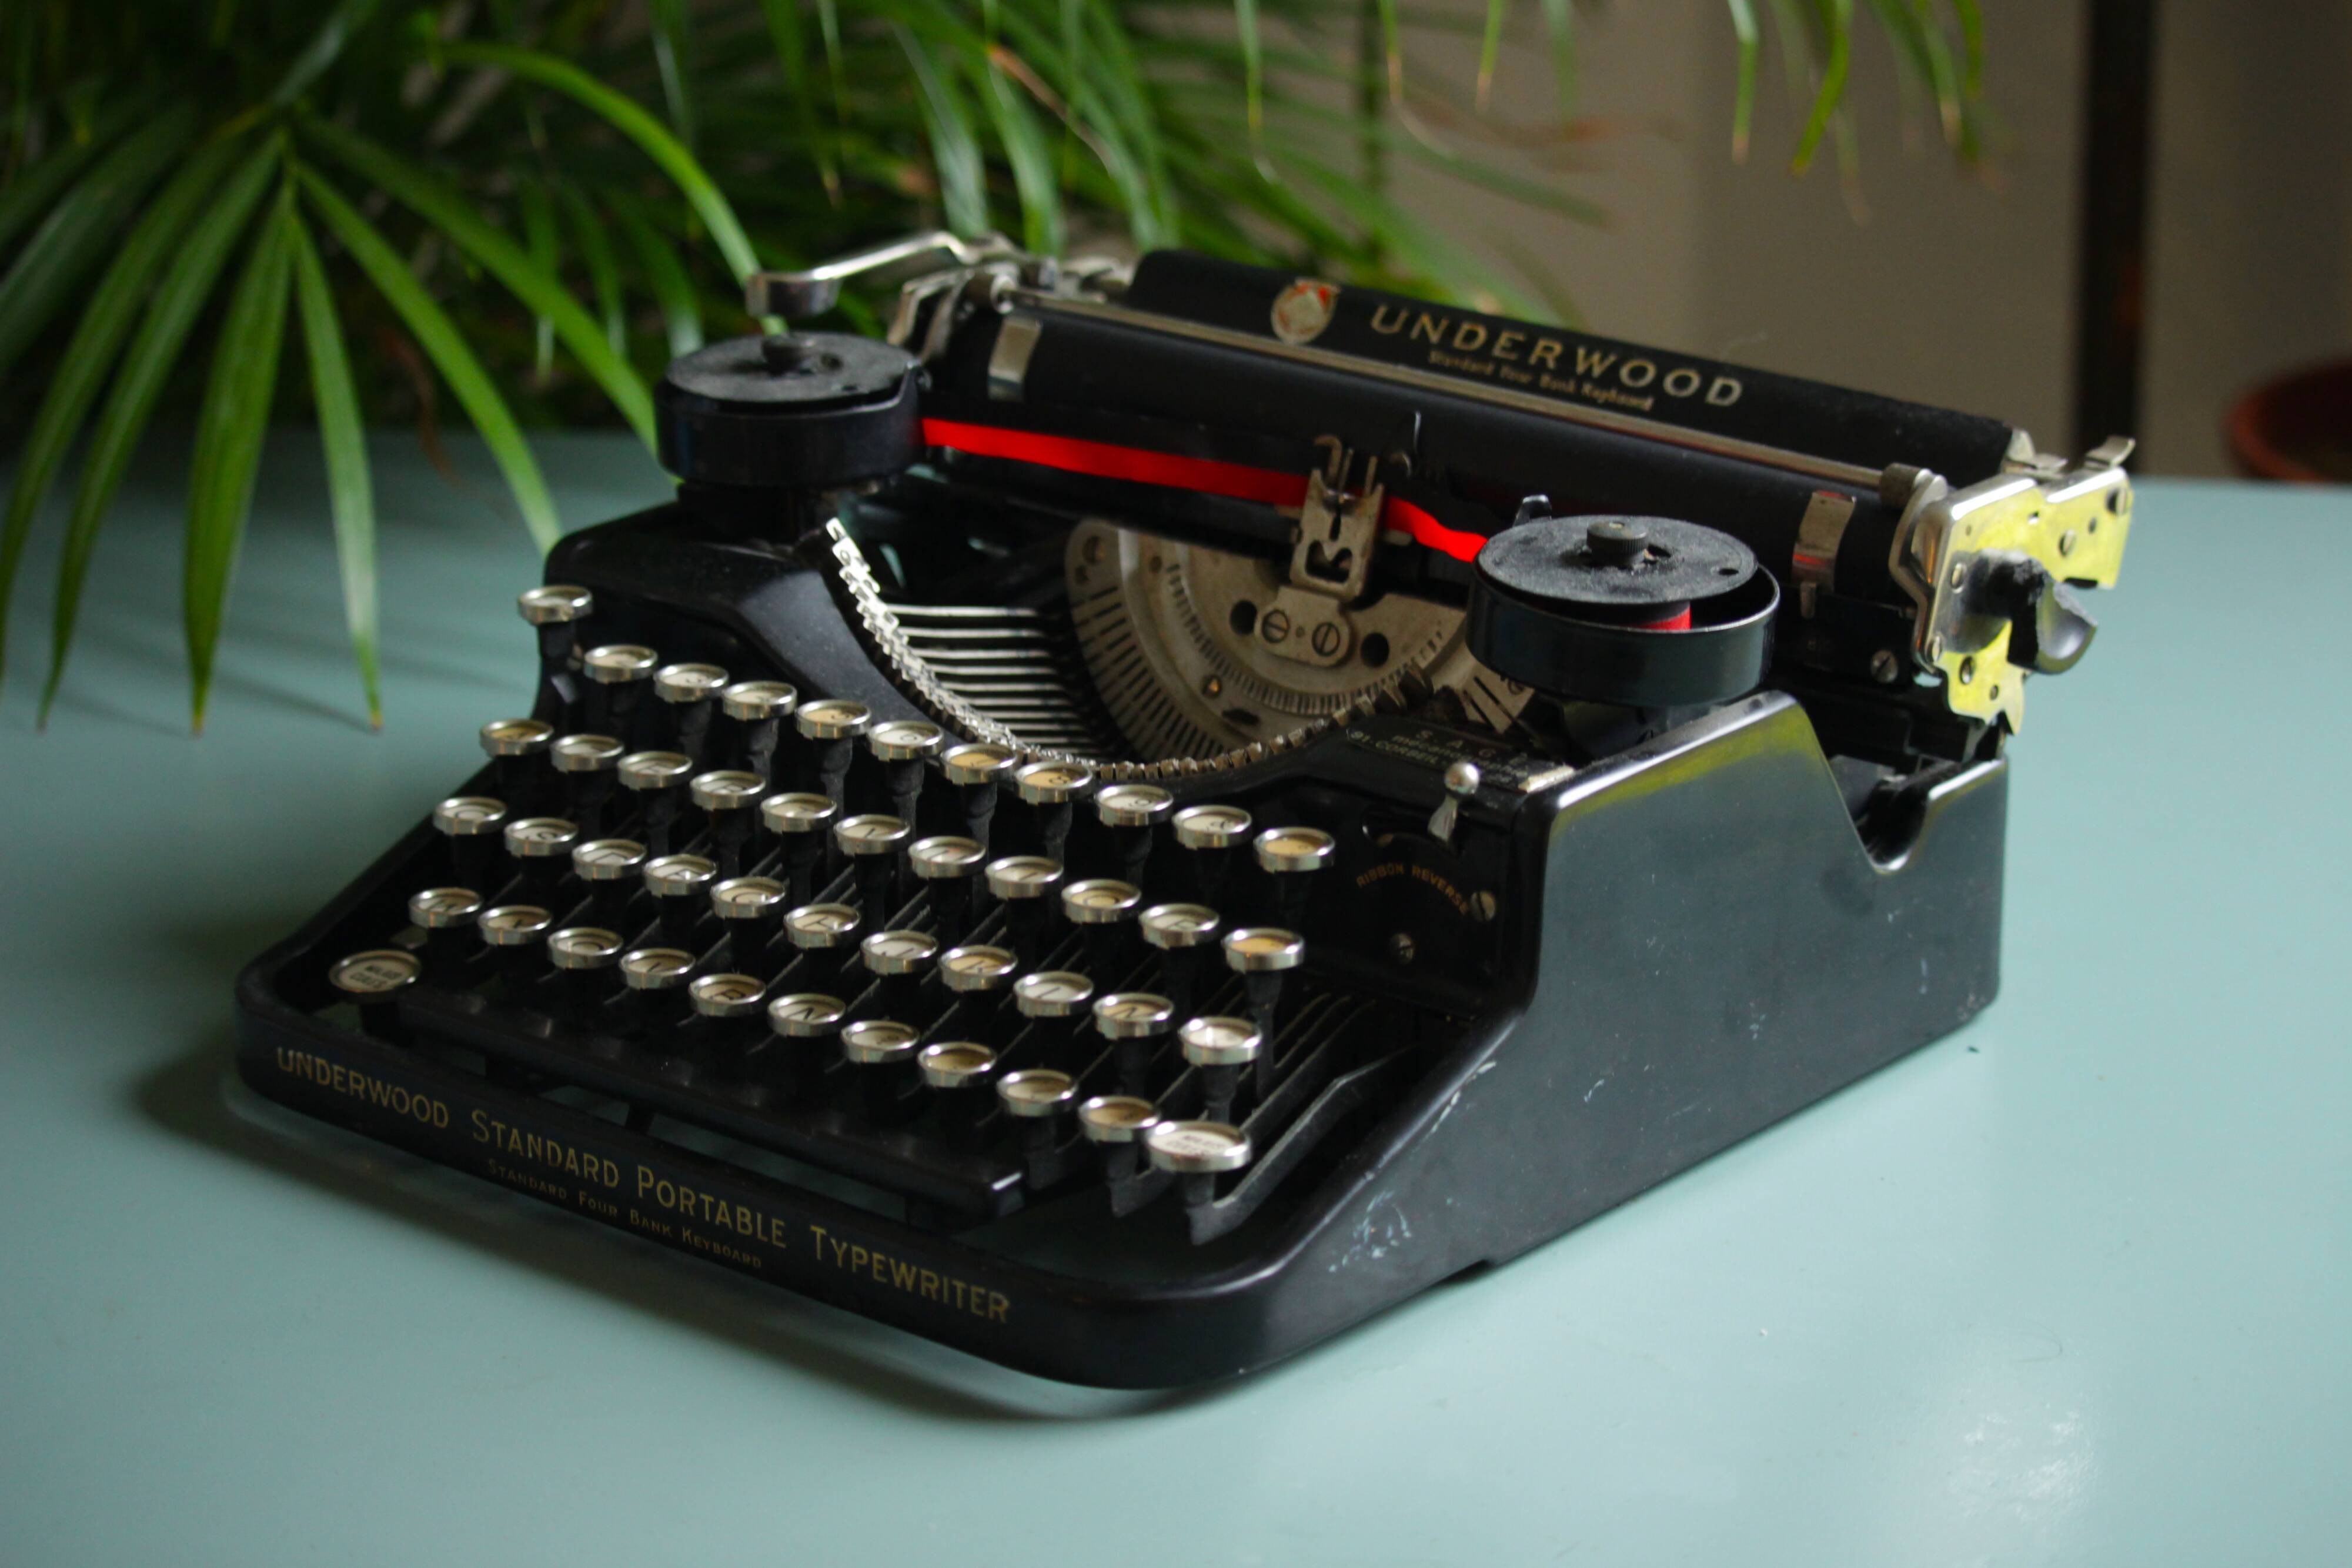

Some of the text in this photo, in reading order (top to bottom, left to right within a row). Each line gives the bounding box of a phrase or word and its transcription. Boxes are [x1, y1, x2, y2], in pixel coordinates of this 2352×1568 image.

[1371, 305, 1743, 407] UNDERWOOD
[1356, 862, 1469, 915] RIBBON REVERSE
[277, 1047, 450, 1129] UNDERWOOD
